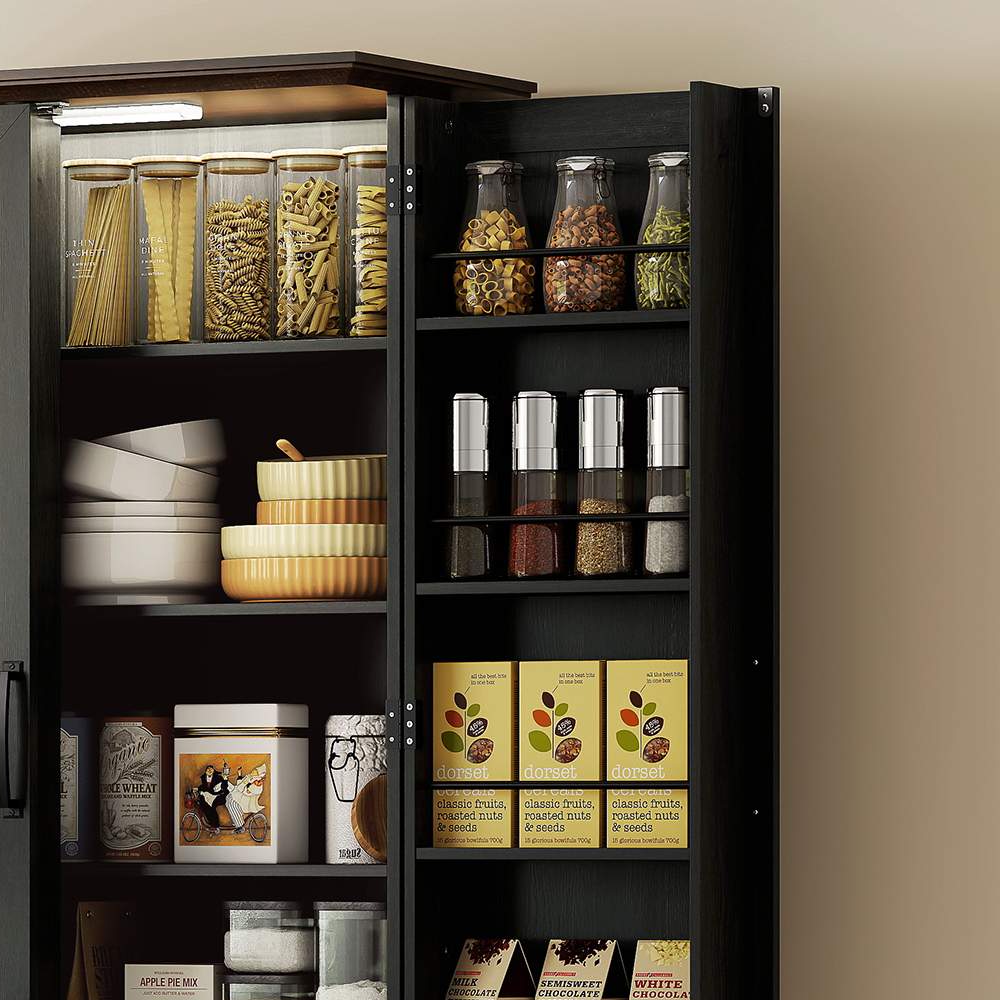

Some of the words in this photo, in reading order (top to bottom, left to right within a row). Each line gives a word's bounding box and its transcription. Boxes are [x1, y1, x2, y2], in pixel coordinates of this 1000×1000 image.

[469, 720, 484, 732] 48%
[557, 719, 571, 731] 48%
[645, 718, 660, 730] 48%
[101, 737, 151, 780] Organic
[437, 765, 490, 779] dorset
[524, 764, 577, 779] dorset
[611, 764, 666, 779] dorset
[122, 783, 157, 793] WHEAT
[437, 799, 473, 809] classic
[475, 799, 506, 811] fruits,
[524, 799, 560, 809] classic
[562, 799, 595, 811] fruits,
[612, 799, 648, 809] classic
[650, 799, 683, 810] fruits,
[437, 811, 477, 820] roasted
[478, 812, 503, 820] nuts
[524, 811, 564, 820] roasted
[566, 812, 591, 820] nuts
[612, 811, 652, 820] roasted
[654, 812, 680, 820] nuts
[437, 822, 446, 832] &
[448, 823, 477, 832] seeds
[524, 822, 534, 832] &
[536, 823, 565, 832] seeds
[612, 822, 621, 832] &
[623, 823, 653, 832] seeds
[140, 977, 166, 987] APPLE
[168, 977, 180, 987] PIE
[182, 977, 198, 987] MIX
[451, 978, 479, 987] MILK
[540, 980, 603, 988] SEMISWEET
[634, 980, 683, 989] WHITE
[448, 989, 497, 997] CHOCOLATE
[538, 989, 600, 998] CHOCOLATE
